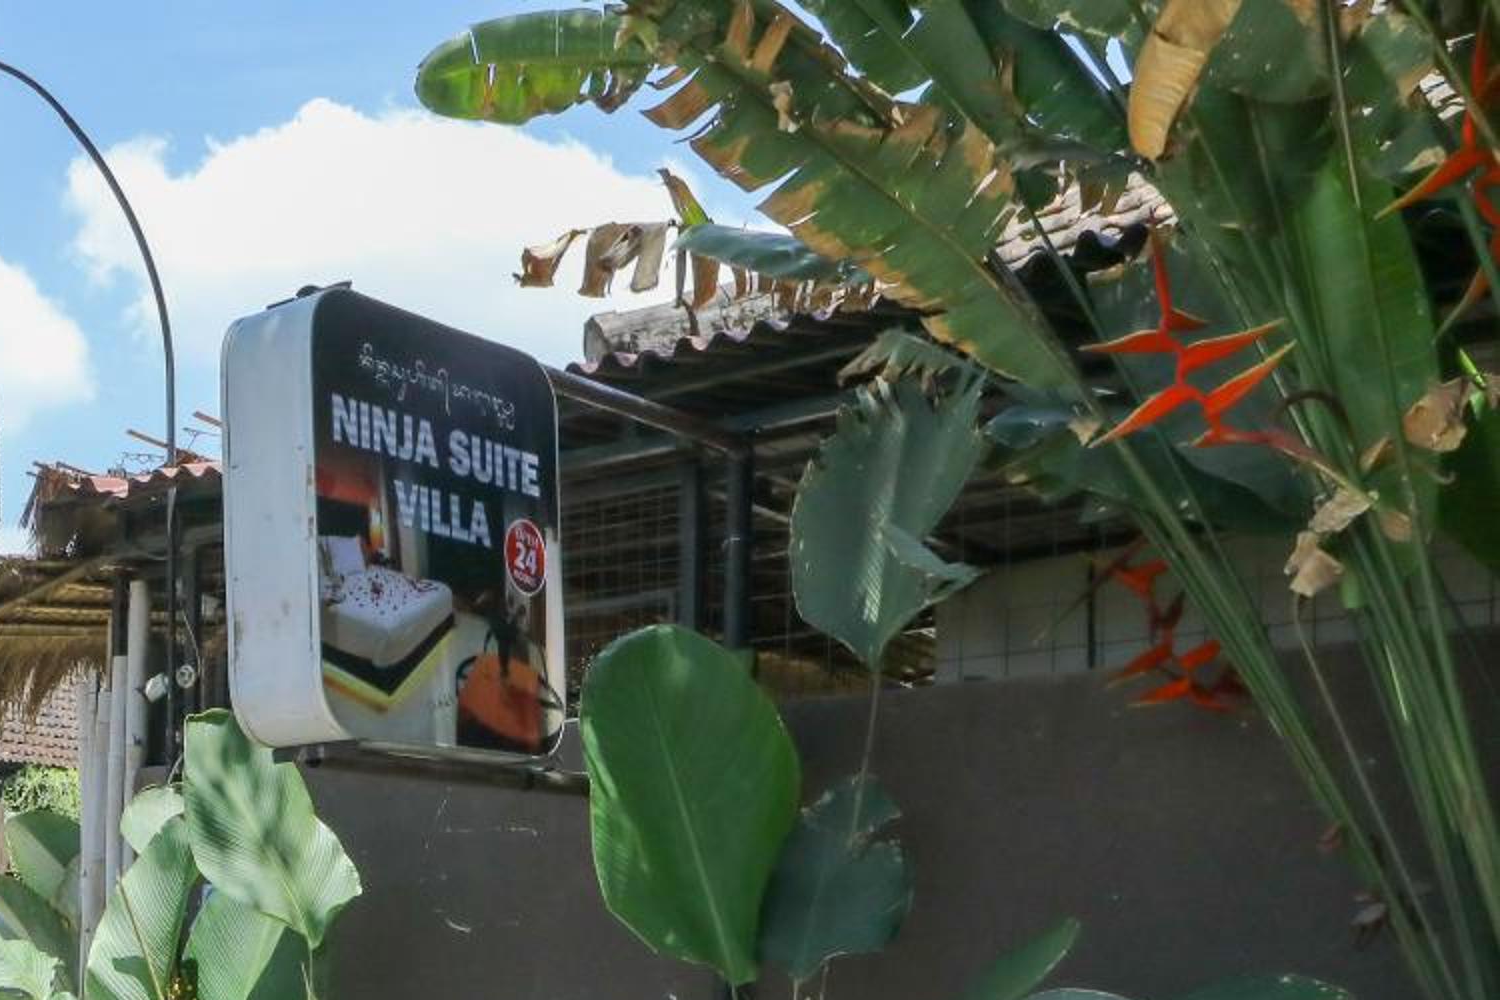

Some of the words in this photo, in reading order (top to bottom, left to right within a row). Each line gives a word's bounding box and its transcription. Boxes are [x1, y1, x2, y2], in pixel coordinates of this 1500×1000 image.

[331, 393, 439, 468] NINJA
[449, 429, 541, 497] SUITE
[393, 479, 491, 548] VILLA
[514, 541, 538, 576] 24
